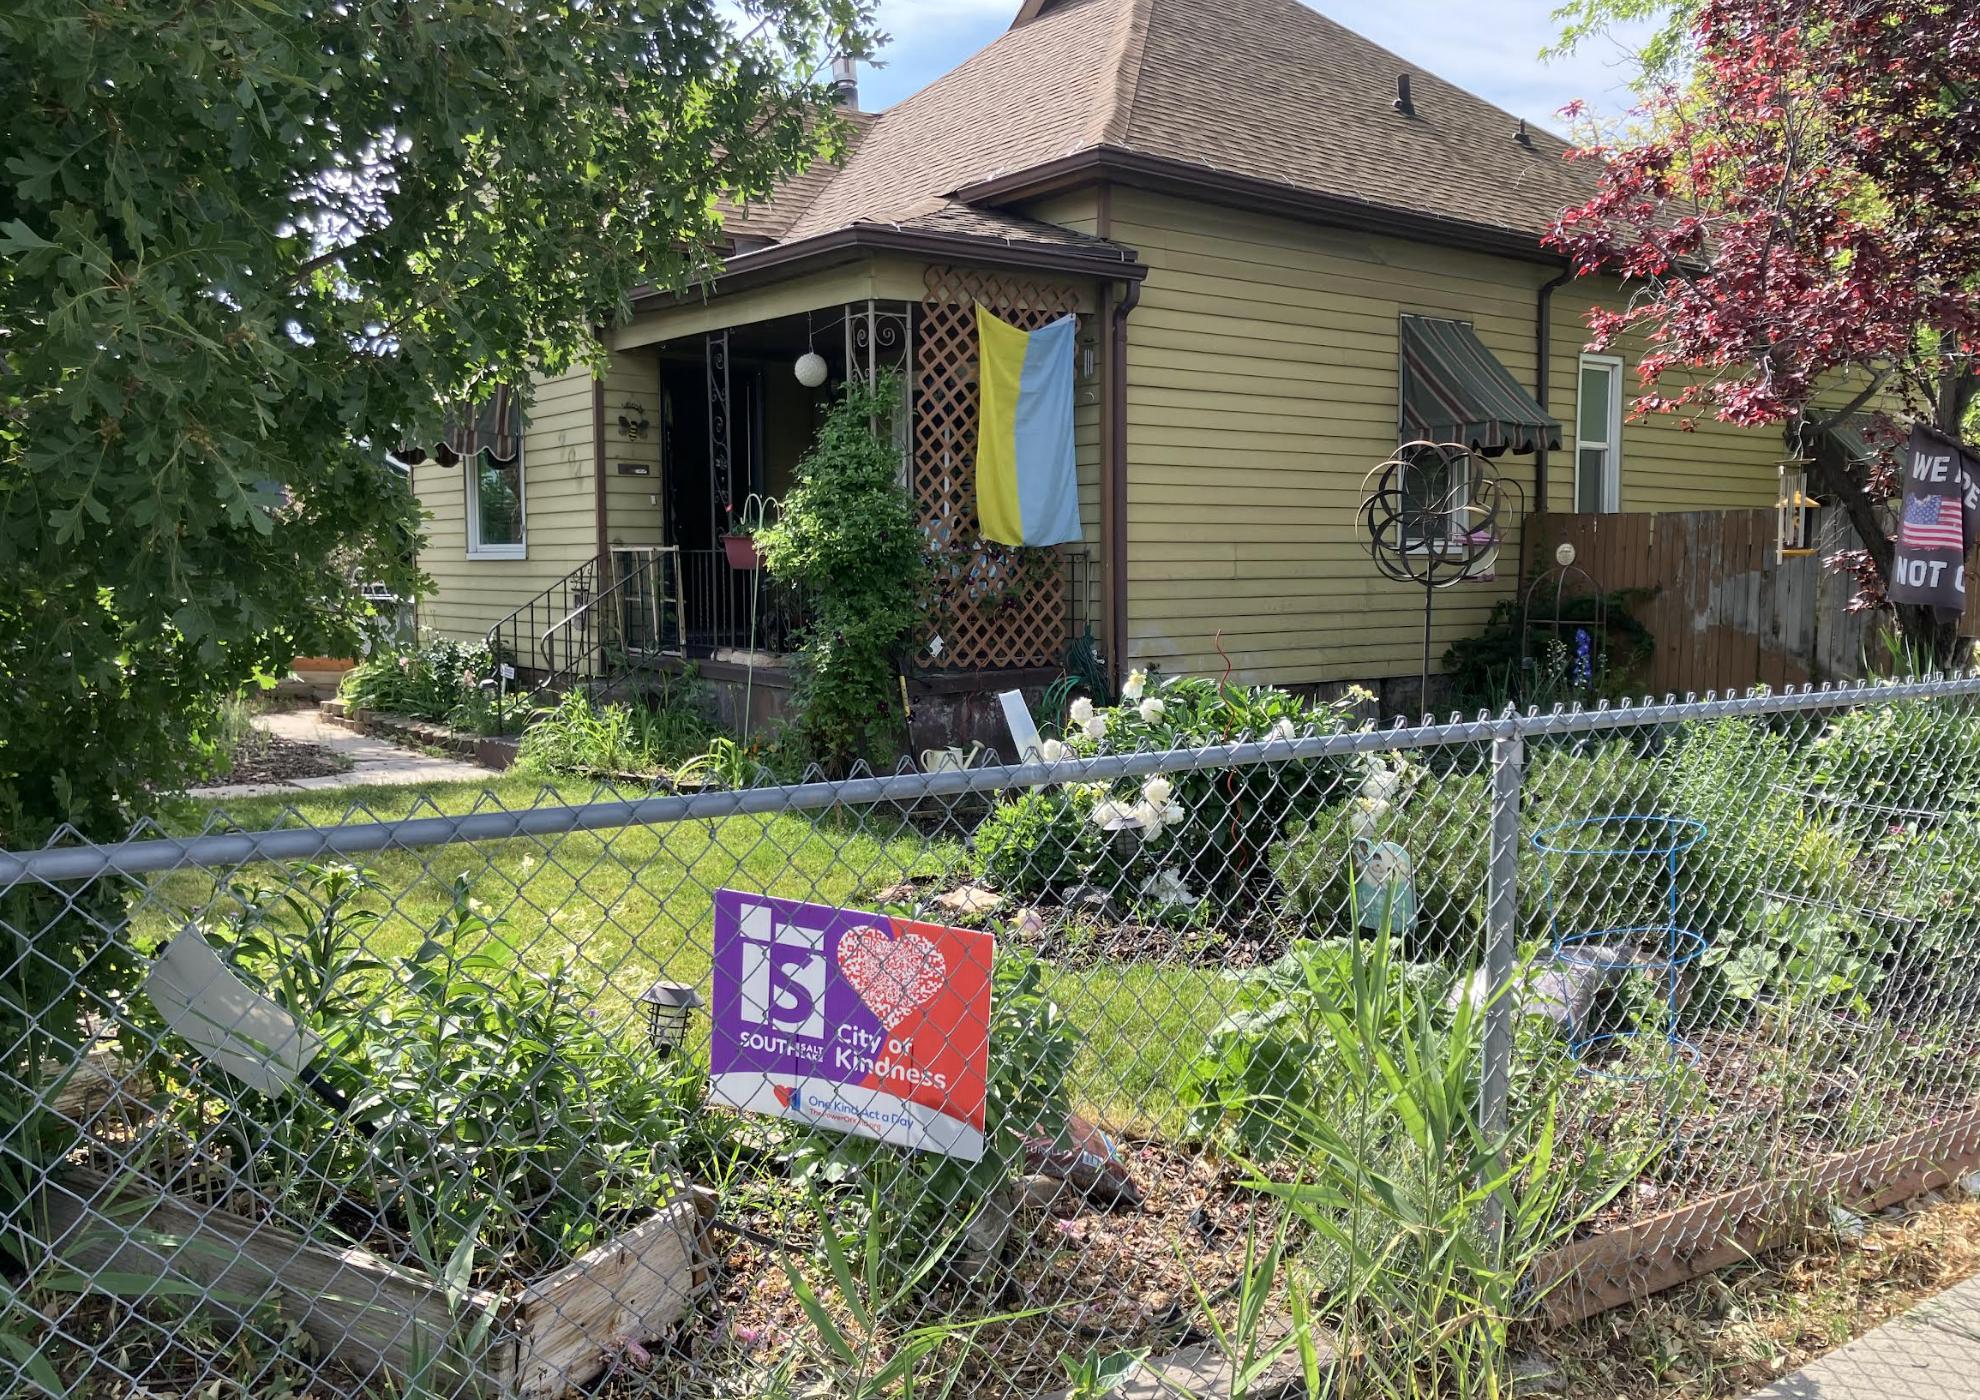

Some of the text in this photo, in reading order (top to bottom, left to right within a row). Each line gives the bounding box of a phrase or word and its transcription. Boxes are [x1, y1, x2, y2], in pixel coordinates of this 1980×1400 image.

[1912, 451, 1950, 482] WE
[1896, 555, 1947, 587] NOT
[740, 1031, 799, 1058] SOUTH
[801, 1043, 823, 1055] SALT
[837, 1024, 914, 1056] City of
[835, 1046, 947, 1090] Kindness
[808, 1095, 914, 1130] One Kind Act a Day
